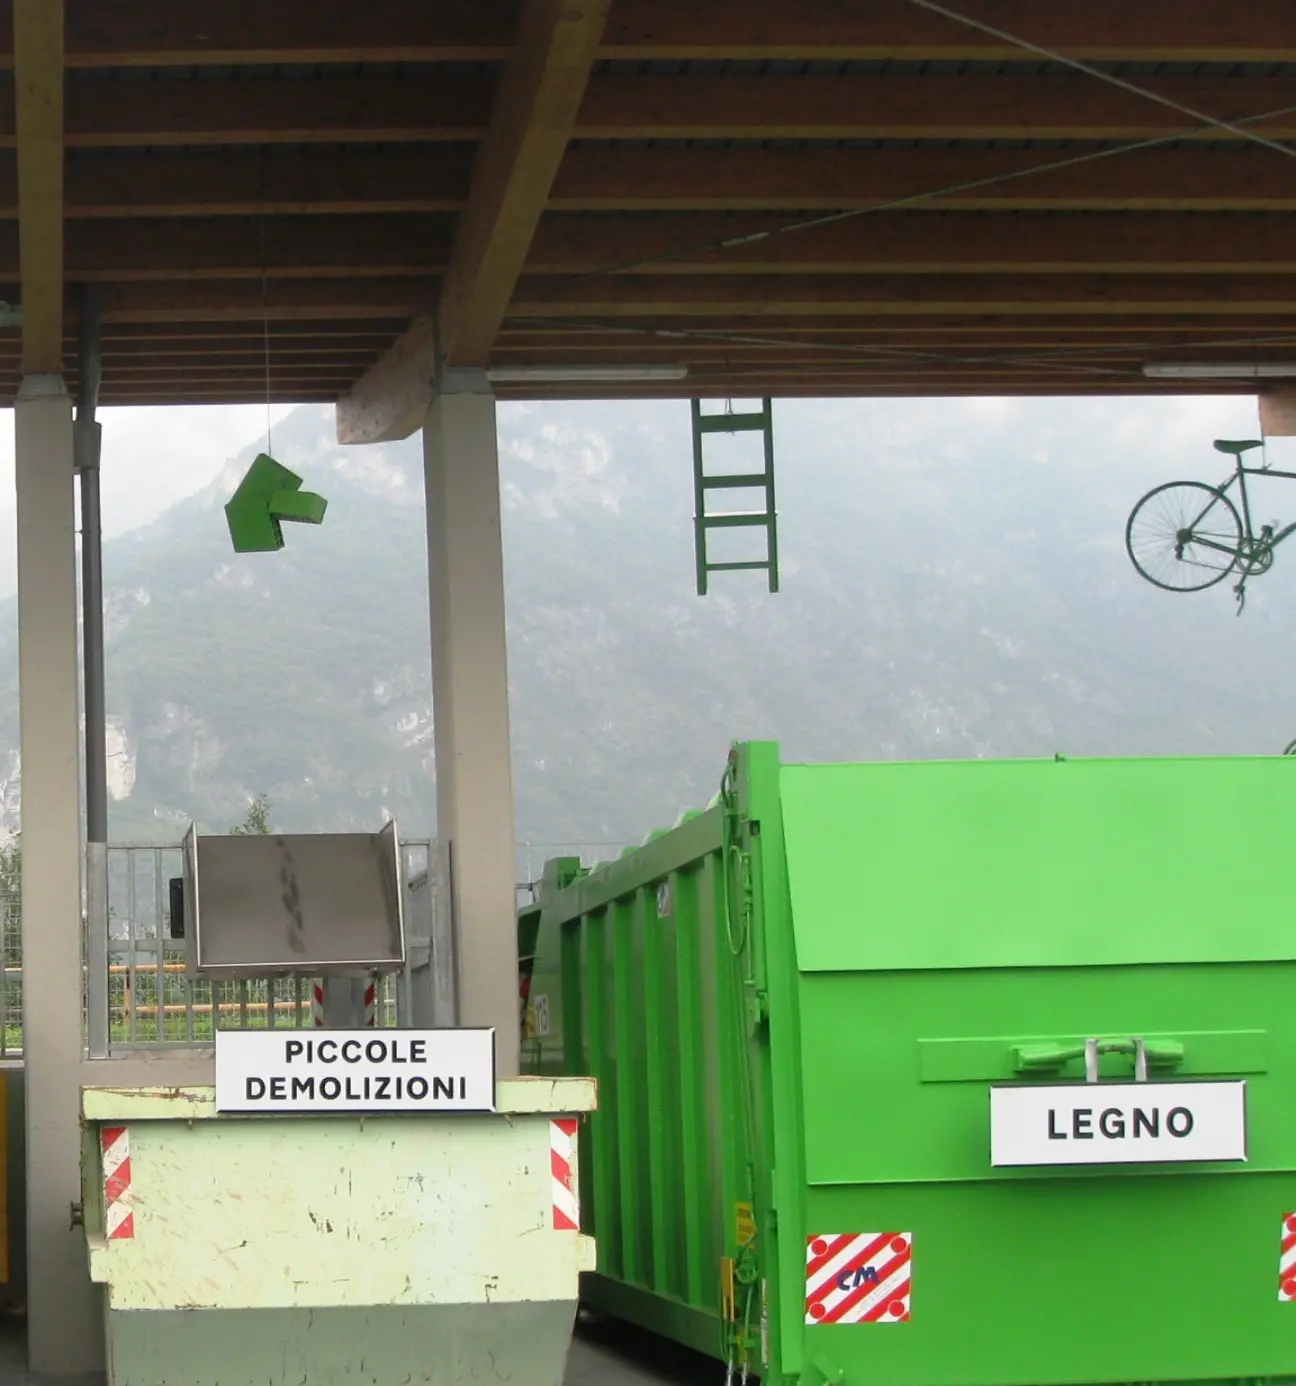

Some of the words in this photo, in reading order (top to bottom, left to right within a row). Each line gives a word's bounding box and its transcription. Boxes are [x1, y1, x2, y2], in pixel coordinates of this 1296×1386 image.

[285, 1040, 427, 1063] PICCOLE
[245, 1076, 466, 1100] DEMOLIZIONI
[1048, 1106, 1194, 1139] LEGNO
[836, 1266, 880, 1291] CM
